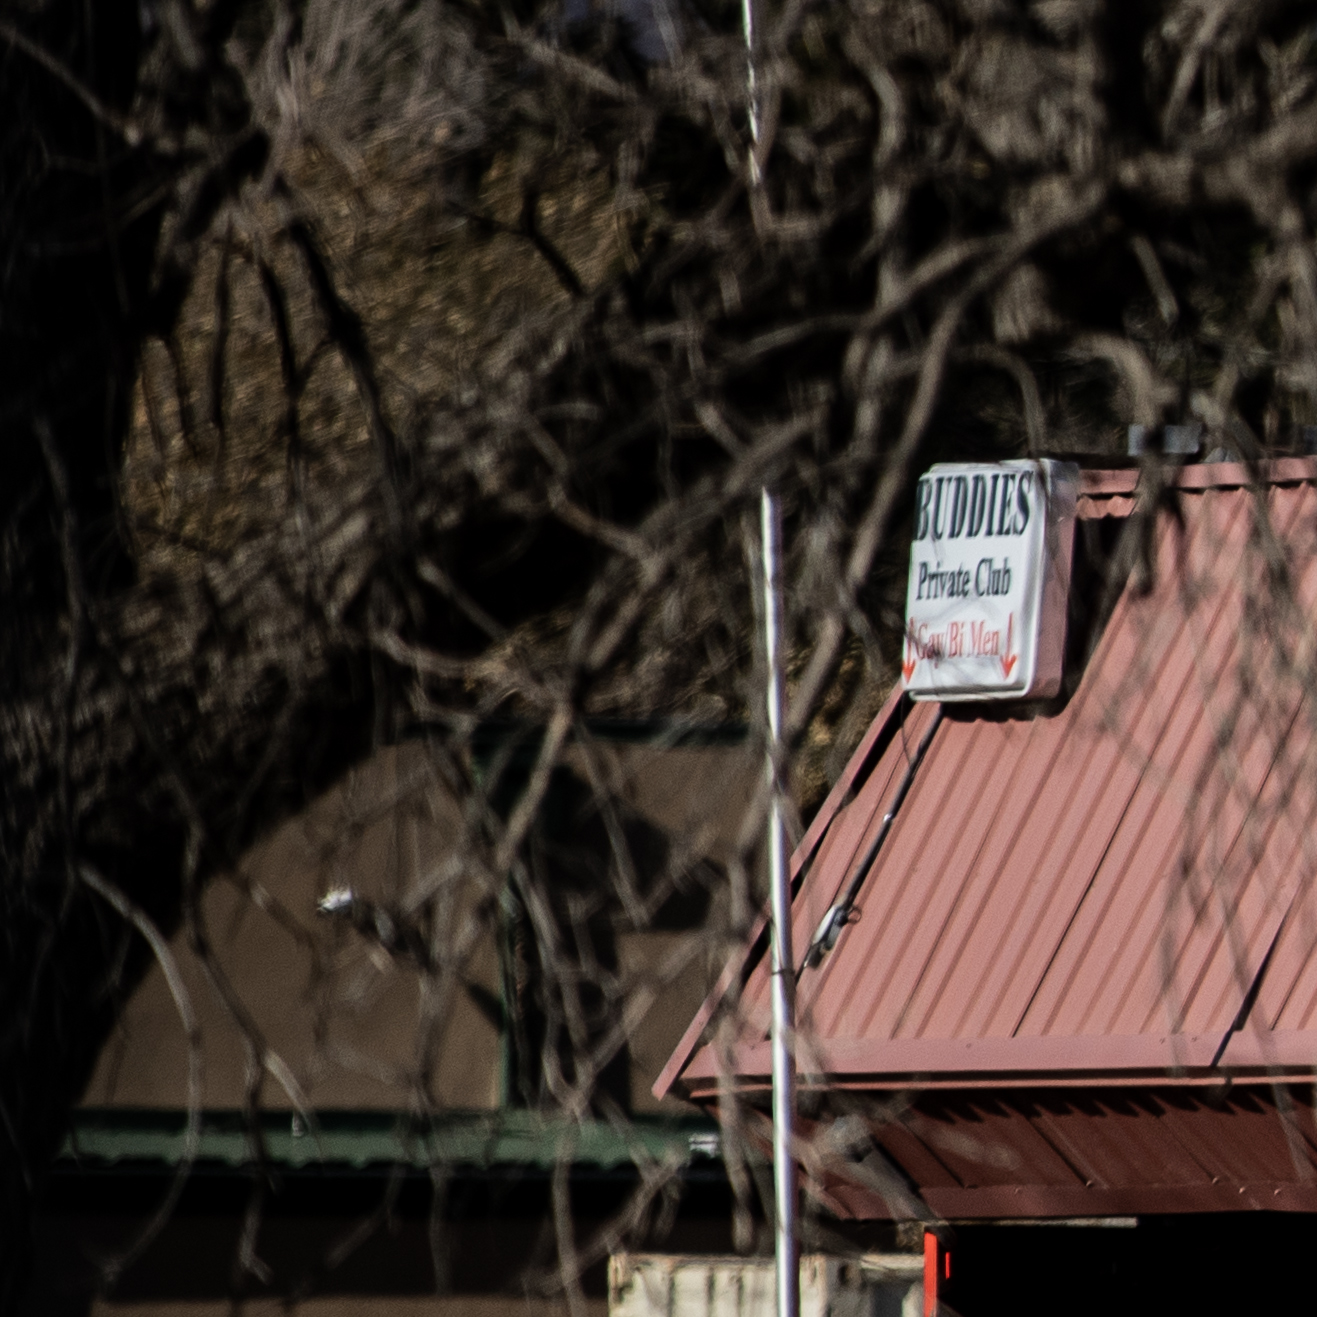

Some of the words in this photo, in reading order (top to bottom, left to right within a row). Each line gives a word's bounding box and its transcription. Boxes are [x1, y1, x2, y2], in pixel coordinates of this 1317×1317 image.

[916, 470, 1035, 542] BUDDIES
[915, 559, 971, 601] Private
[974, 556, 1012, 598] Club
[968, 618, 1001, 658] Men
